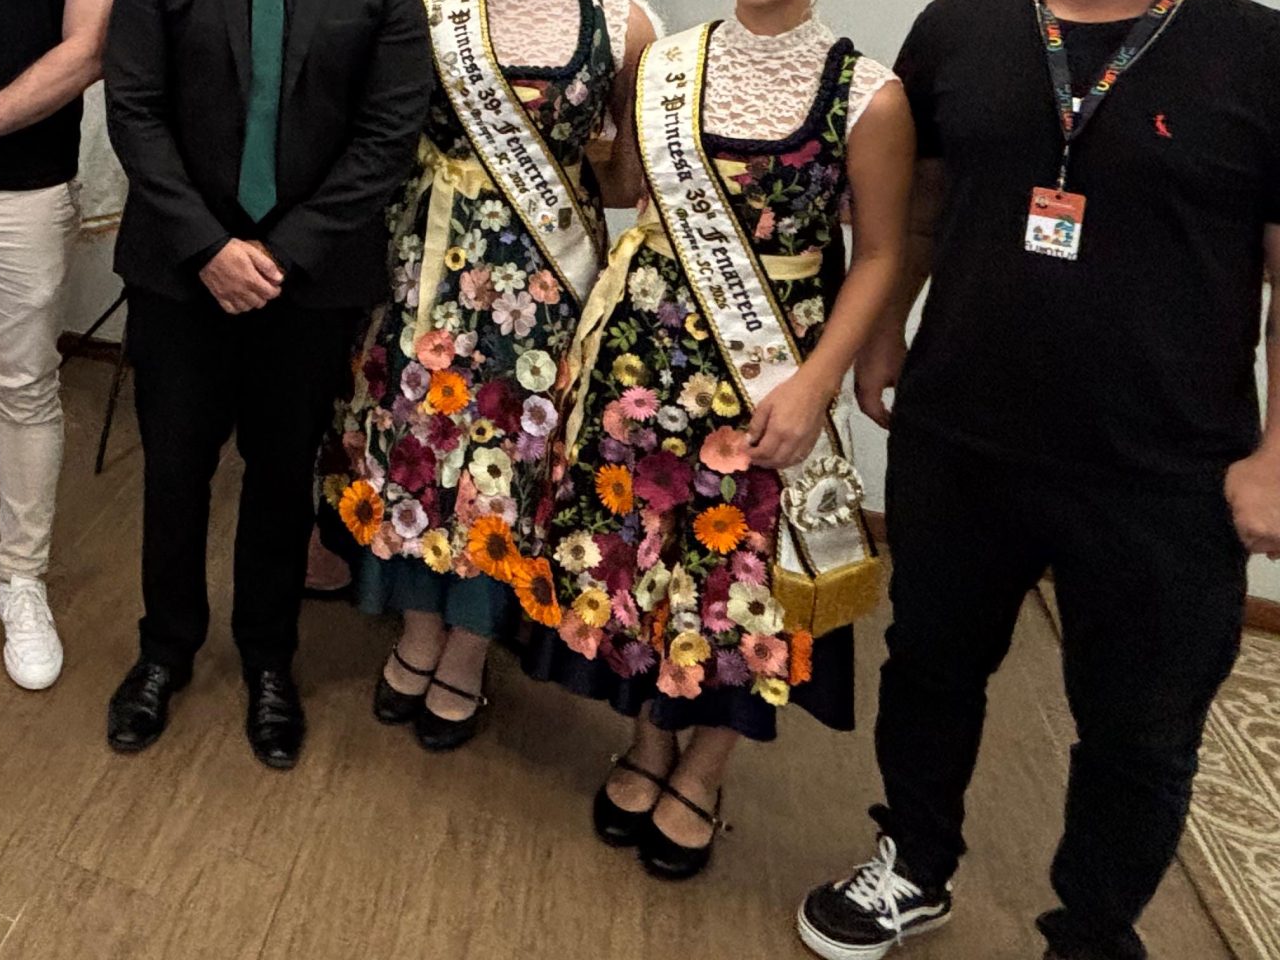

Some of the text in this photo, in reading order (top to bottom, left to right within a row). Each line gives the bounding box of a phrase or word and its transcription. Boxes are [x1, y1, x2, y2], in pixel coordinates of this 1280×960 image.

[447, 8, 483, 85] Princesa
[491, 121, 558, 207] Fenarreco
[494, 152, 511, 166] SC
[508, 171, 530, 194] 2026
[661, 94, 694, 183] Princesa
[696, 227, 762, 333] Fenarreco
[696, 259, 714, 276] SC
[710, 284, 731, 310] 2026
